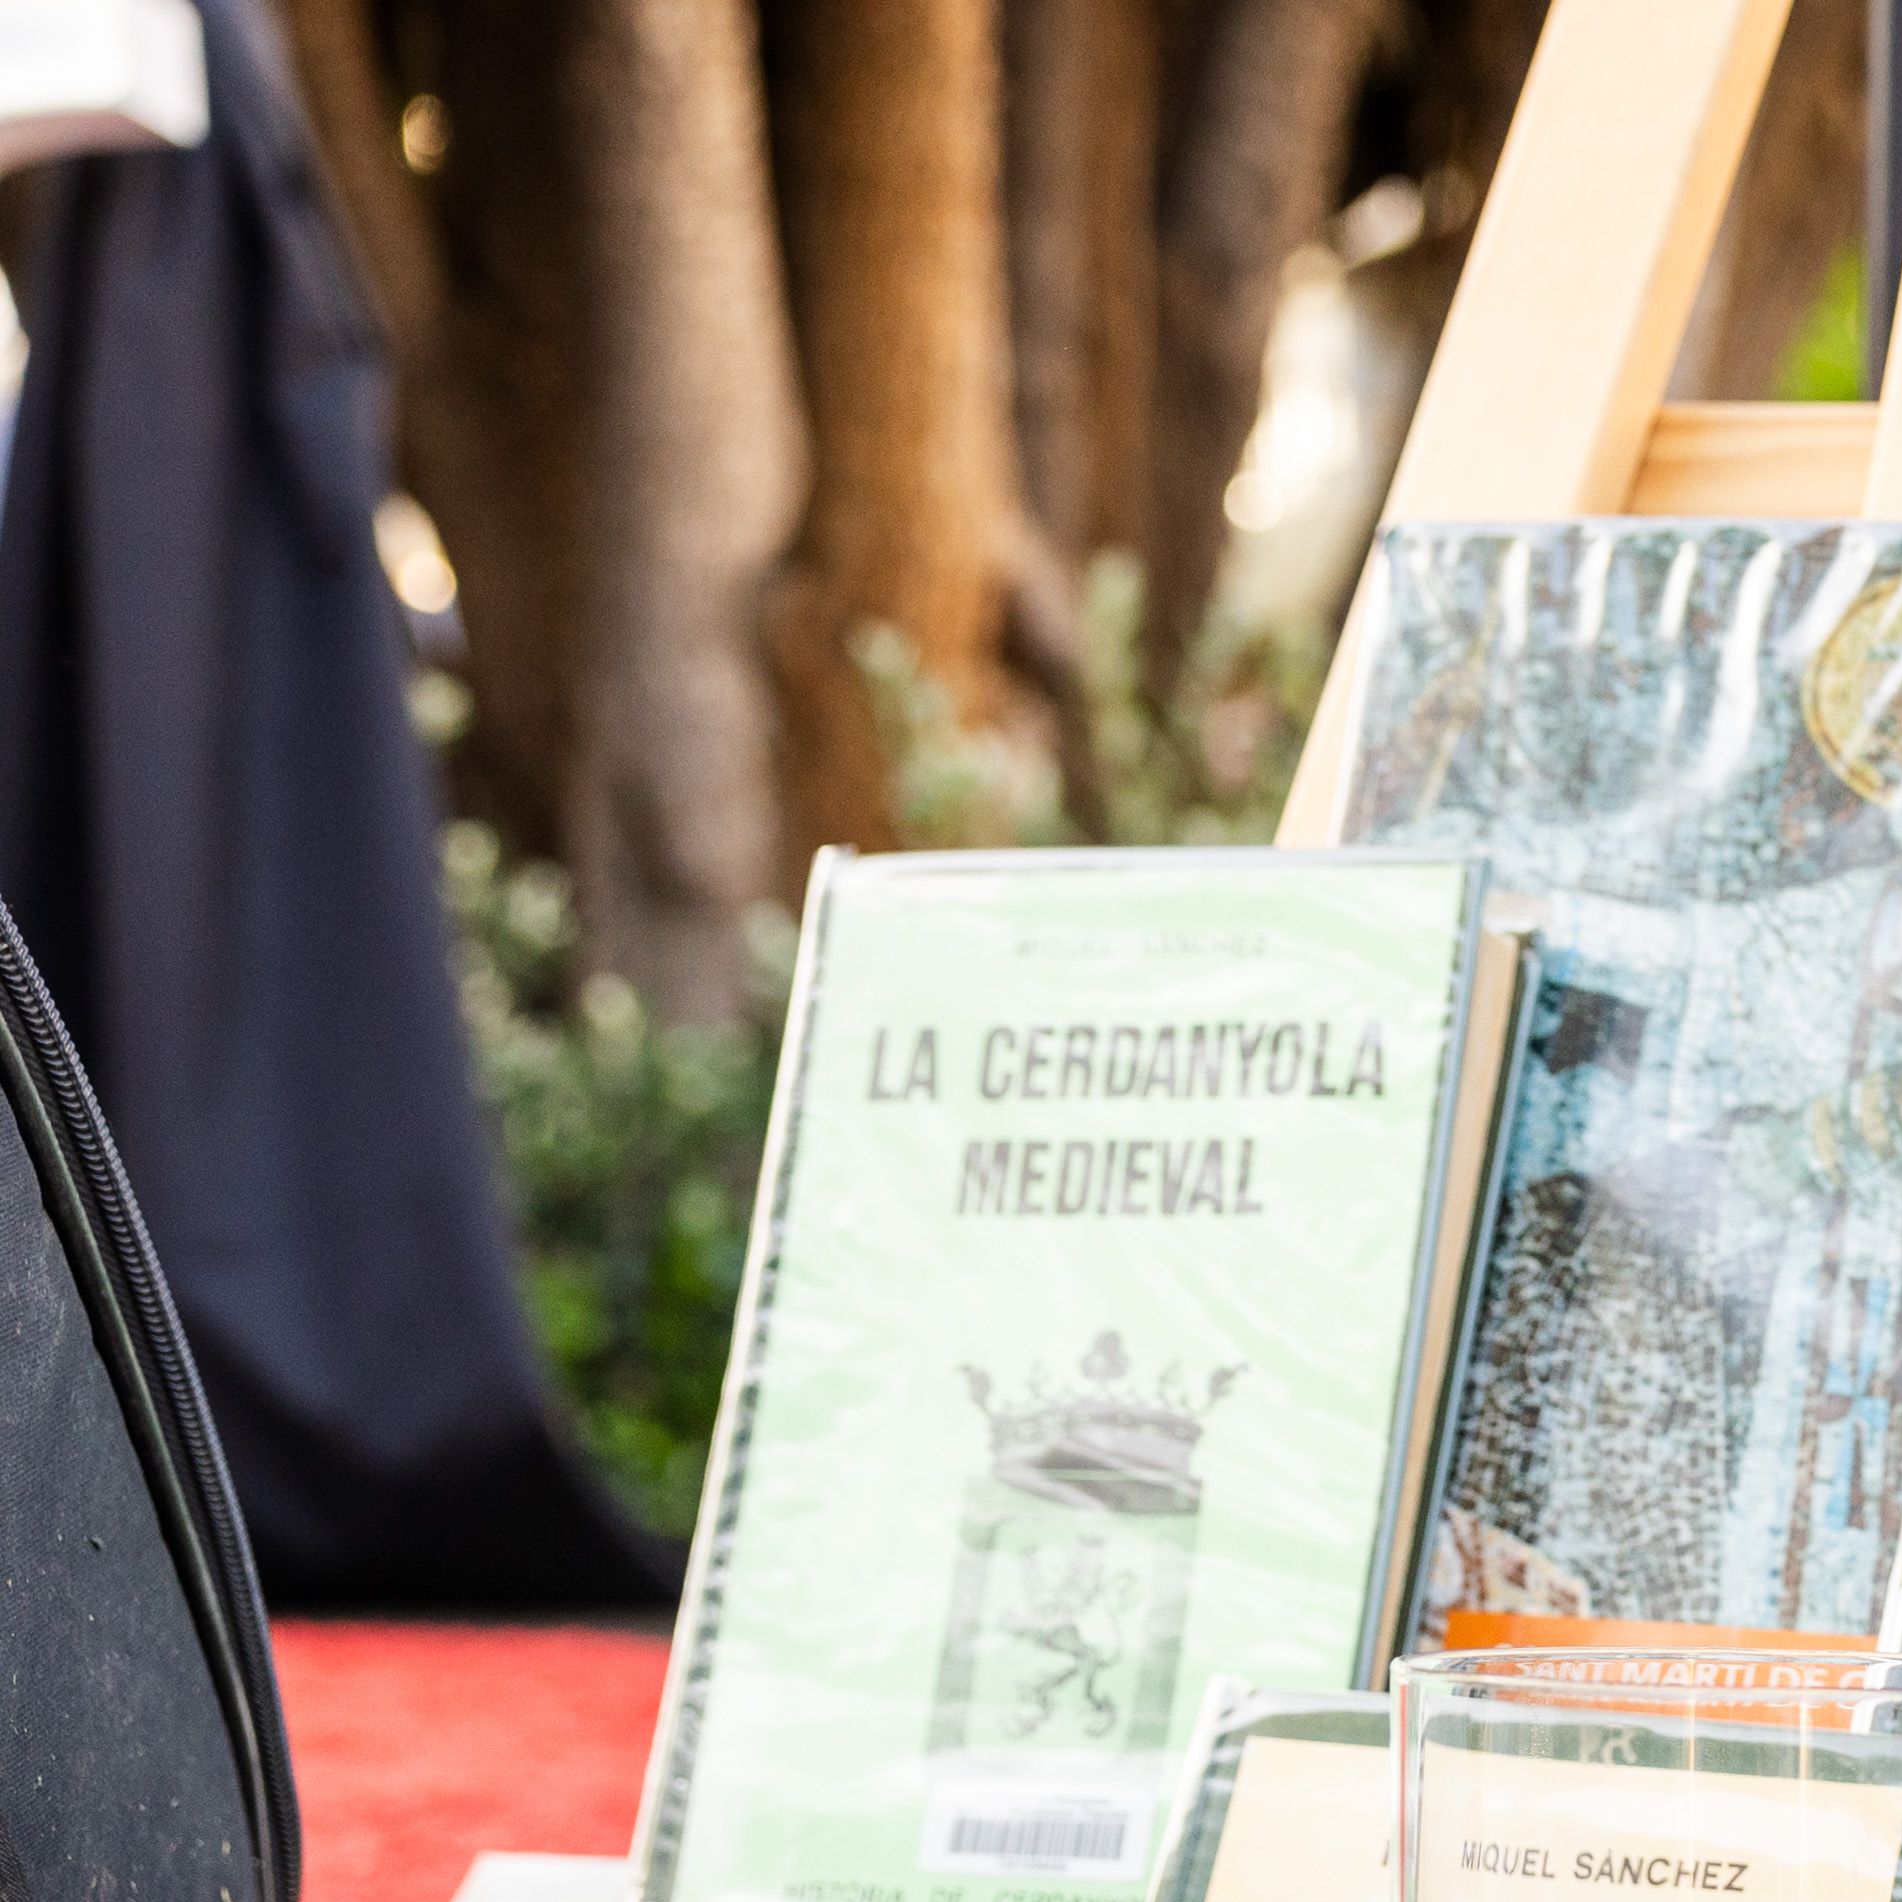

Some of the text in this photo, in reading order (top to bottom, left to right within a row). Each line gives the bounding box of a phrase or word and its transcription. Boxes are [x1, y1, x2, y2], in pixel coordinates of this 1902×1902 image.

[866, 1021, 1385, 1101] LA CERDANYOLA
[955, 1137, 1265, 1217] MEDIEVAL
[1461, 1840, 1556, 1879] MIQUEL
